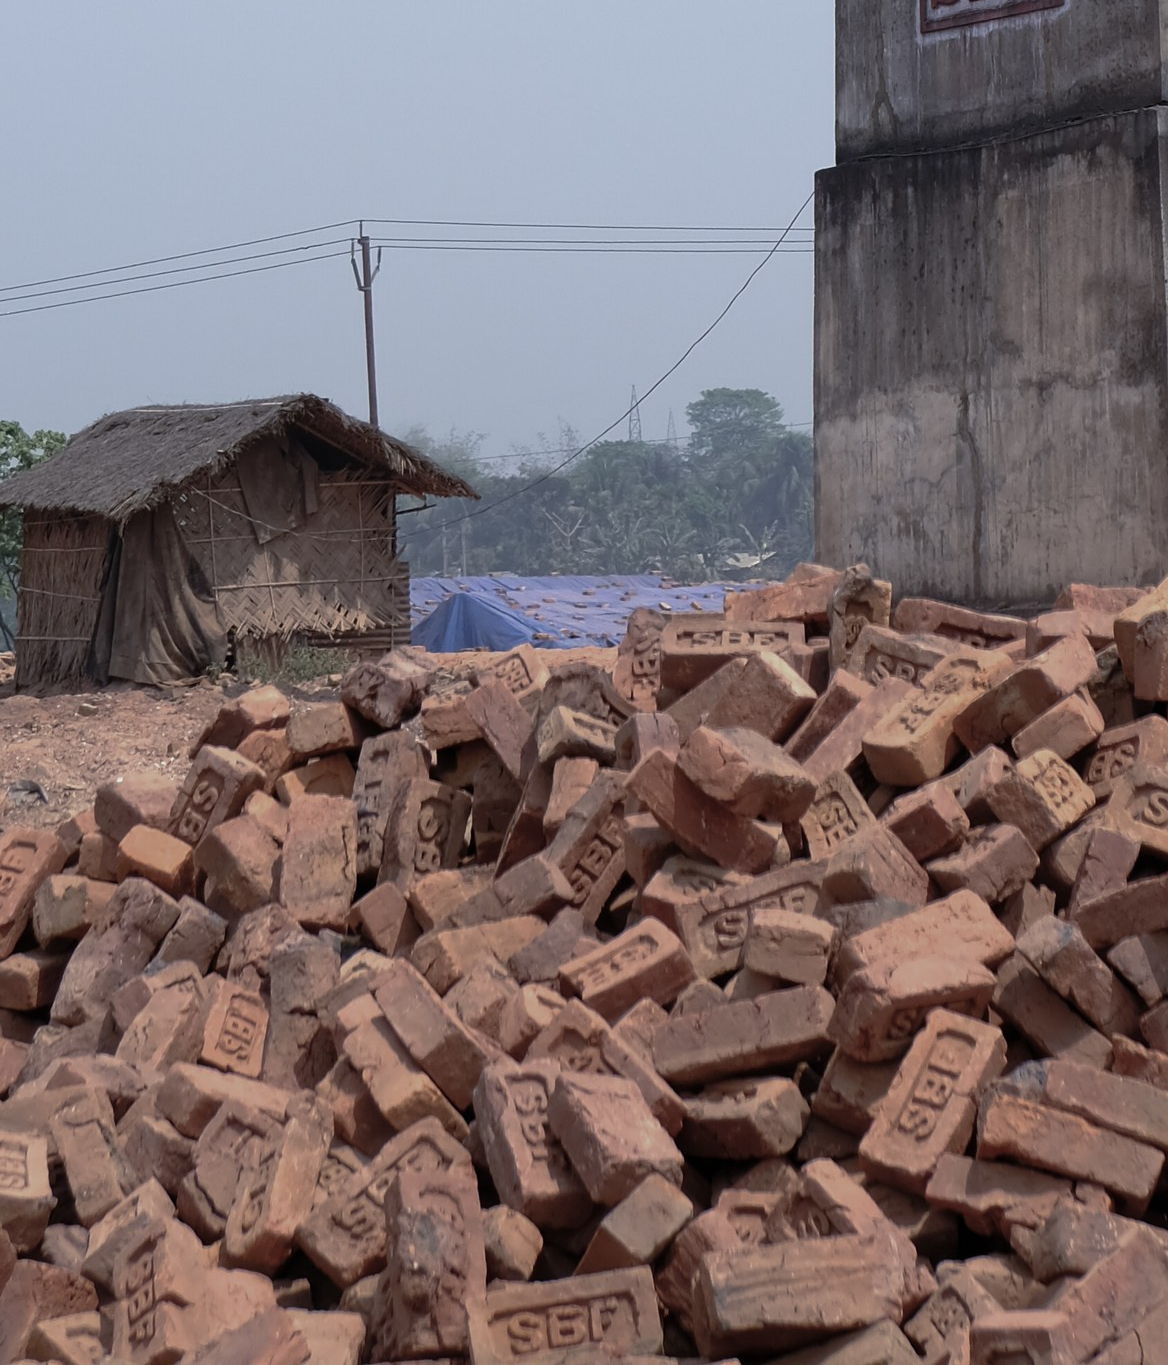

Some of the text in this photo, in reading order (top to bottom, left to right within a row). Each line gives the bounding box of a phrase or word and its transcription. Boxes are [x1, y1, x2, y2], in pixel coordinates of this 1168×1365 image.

[692, 631, 776, 648] SBF
[179, 780, 221, 843] SB
[415, 805, 442, 872] SB
[900, 1040, 965, 1143] SBF
[506, 1297, 619, 1356] SBF
